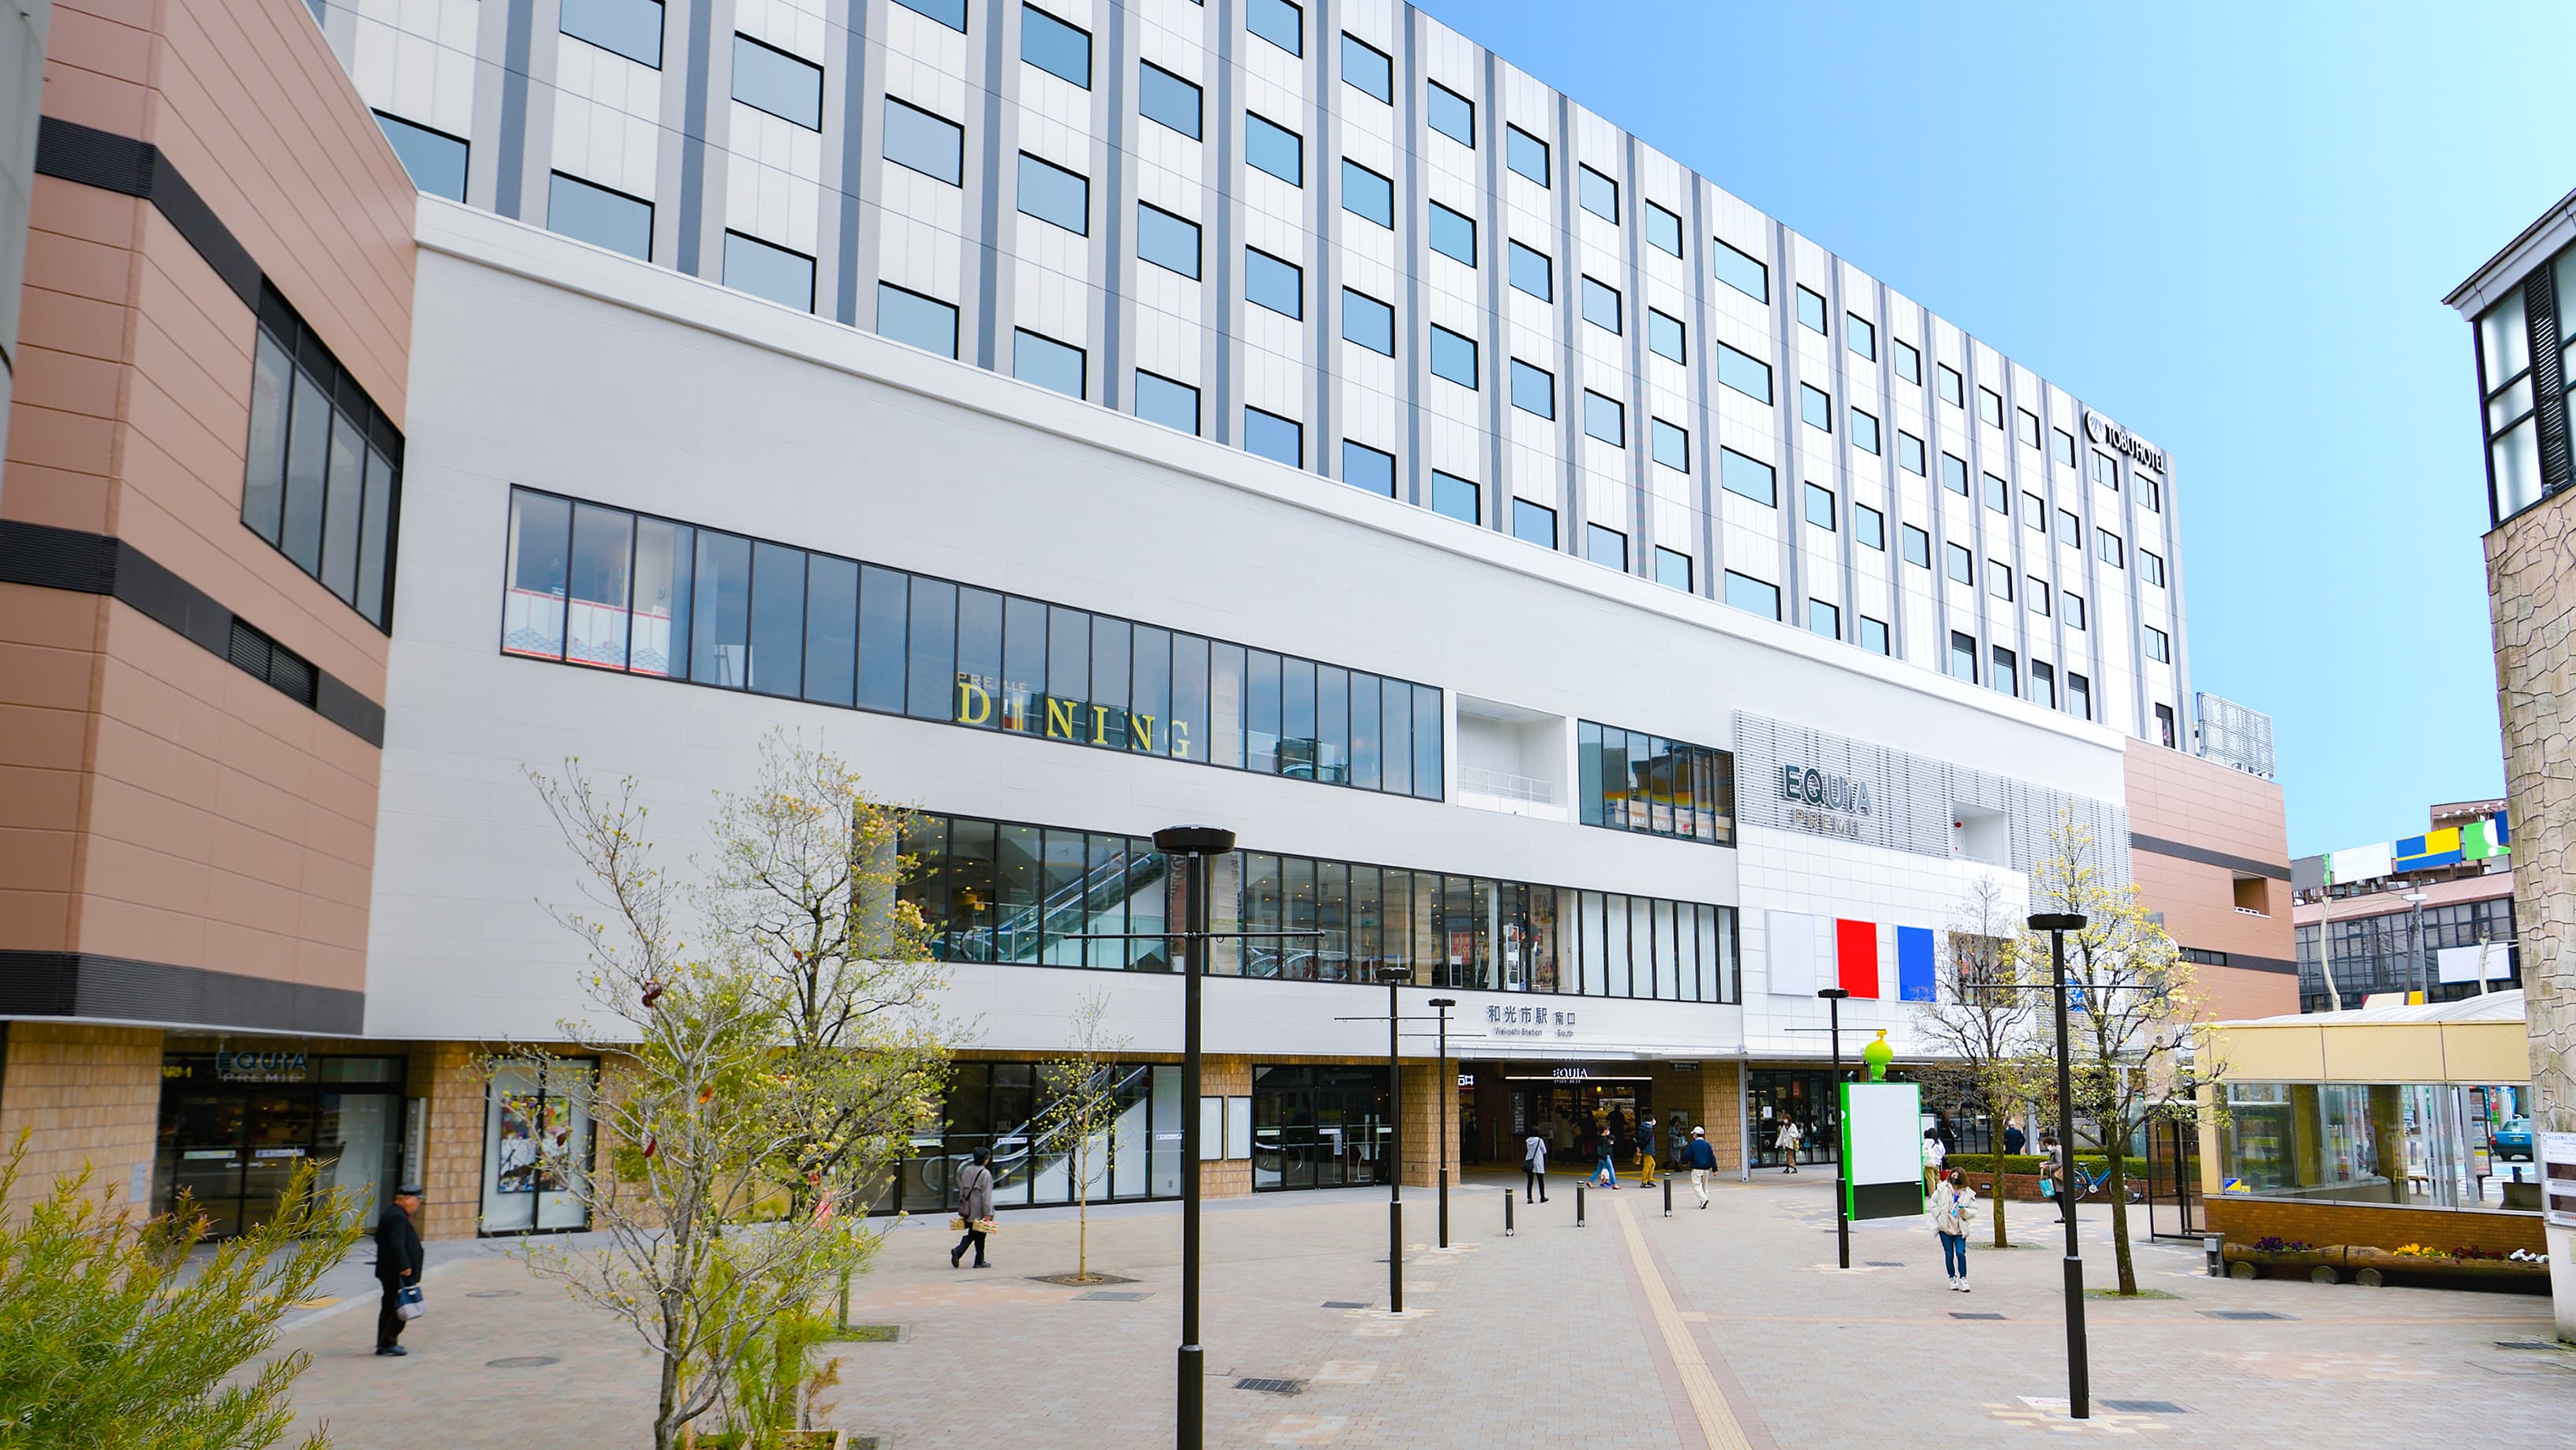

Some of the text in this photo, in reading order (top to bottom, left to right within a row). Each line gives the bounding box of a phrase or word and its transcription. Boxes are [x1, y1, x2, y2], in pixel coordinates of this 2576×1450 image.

[2105, 424, 2167, 475] TOBU HOTEL
[958, 682, 1191, 757] DINING
[1488, 1004, 1576, 1026] 和光市駅 南口
